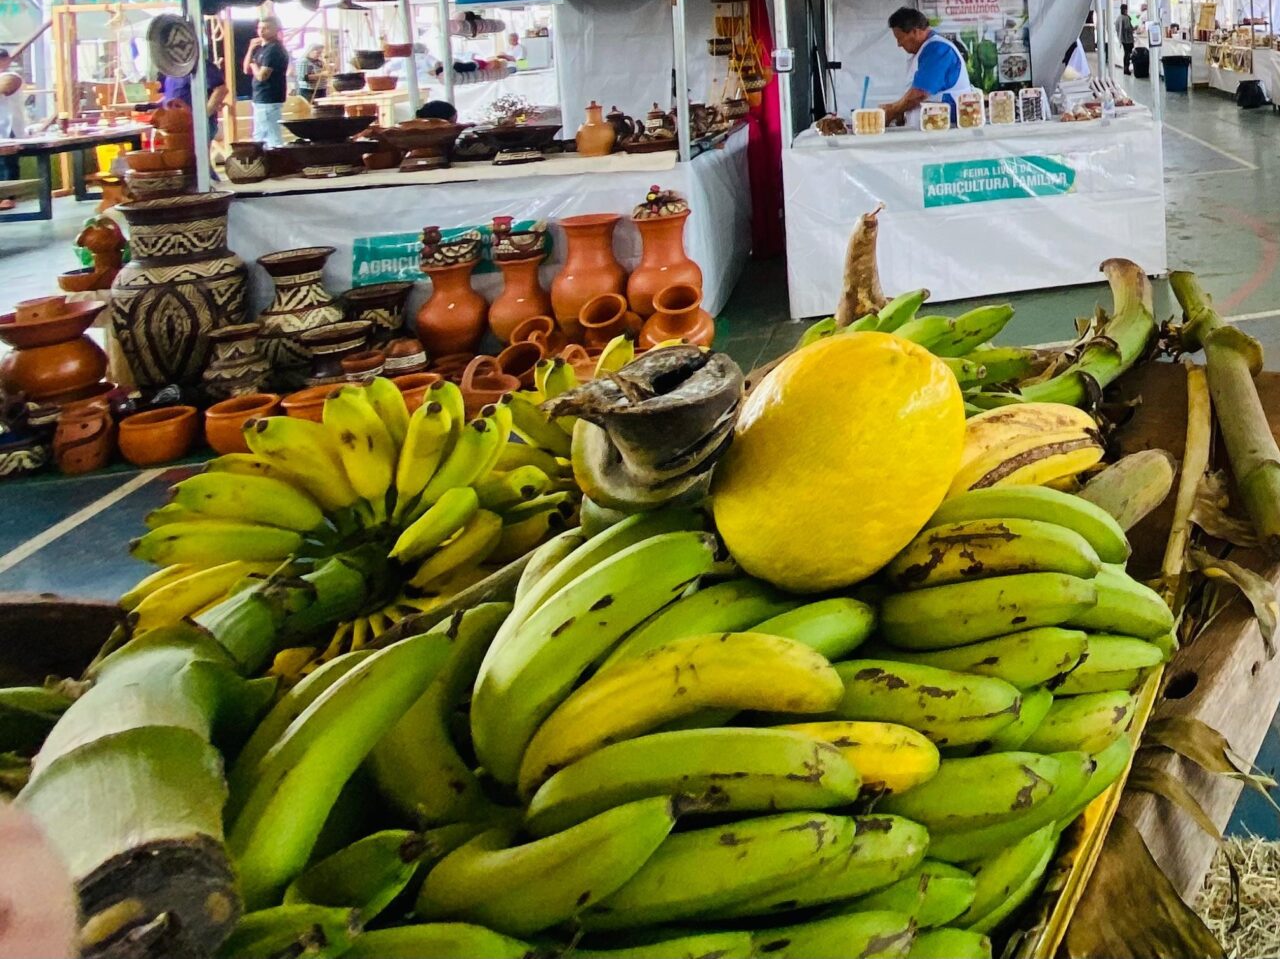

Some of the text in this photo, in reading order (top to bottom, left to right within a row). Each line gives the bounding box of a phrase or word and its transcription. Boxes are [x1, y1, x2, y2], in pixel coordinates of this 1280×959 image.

[963, 166, 990, 179] FEIRA
[927, 171, 1067, 197] AGRICULTURA FAMILIAR
[359, 255, 420, 276] AGRICU
